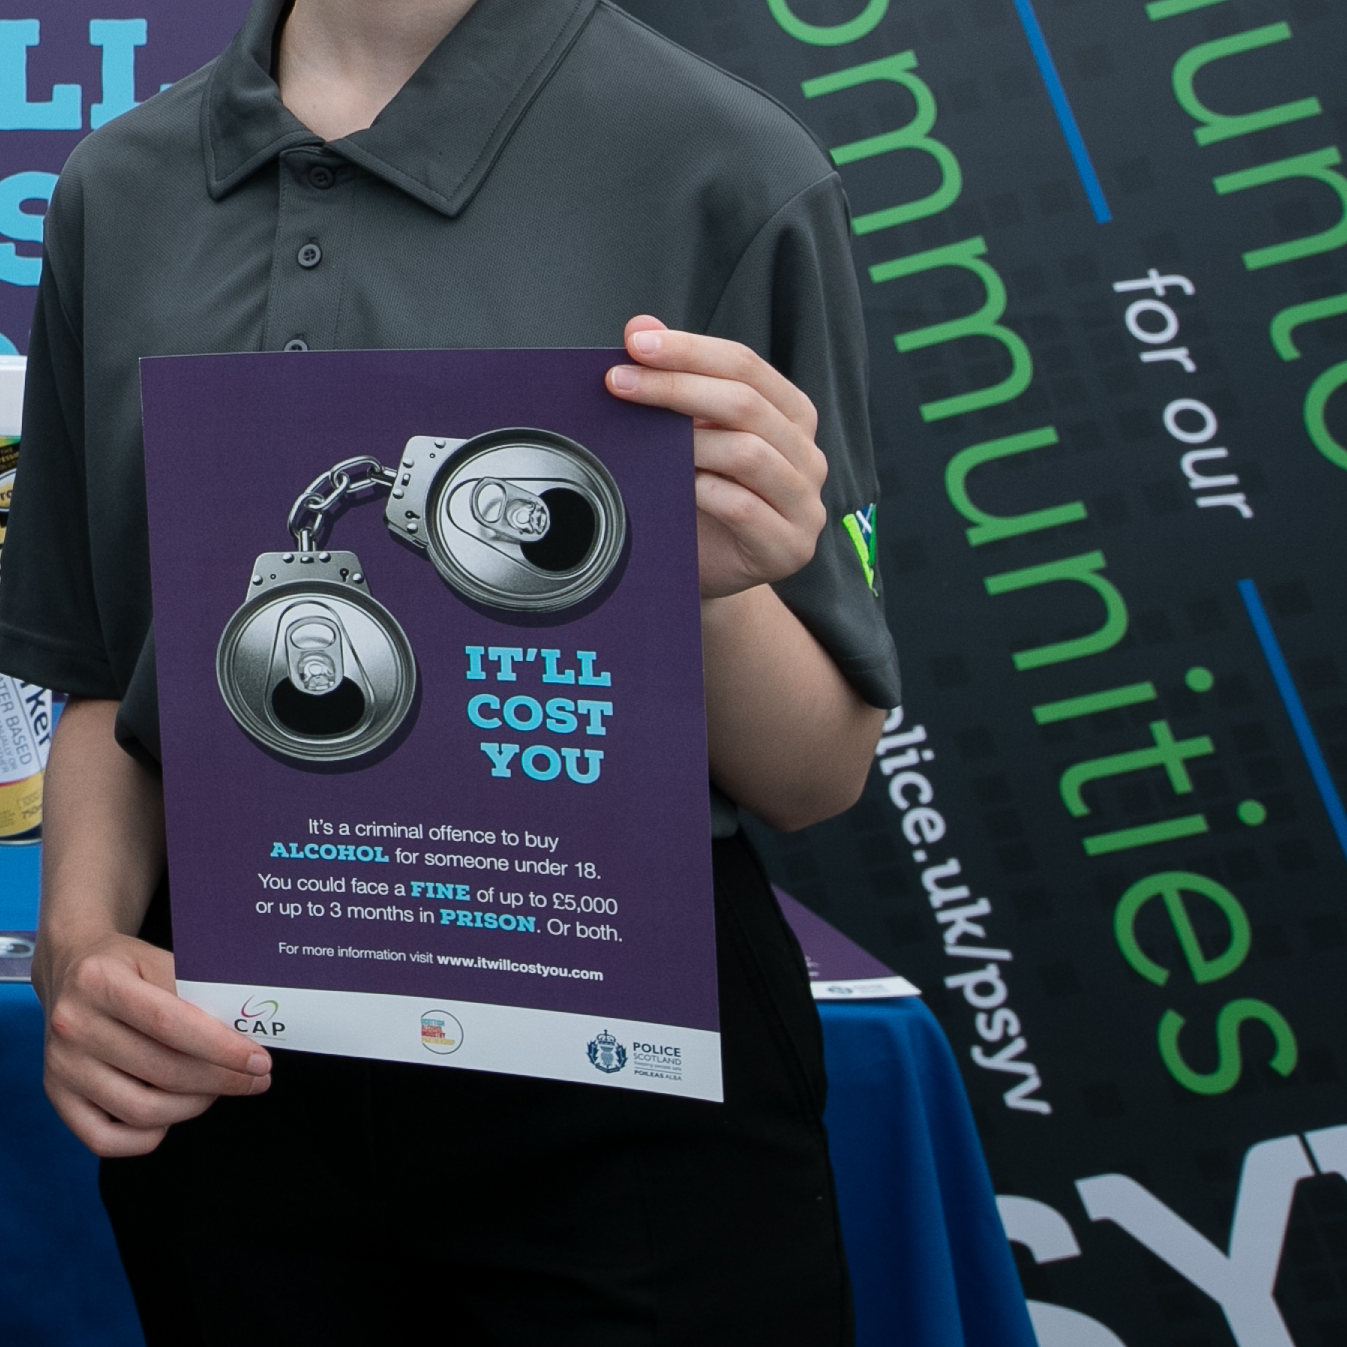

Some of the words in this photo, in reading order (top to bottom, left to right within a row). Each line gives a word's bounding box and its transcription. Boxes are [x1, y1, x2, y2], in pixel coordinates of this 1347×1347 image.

[1112, 267, 1197, 375] for
[1162, 396, 1255, 520] our
[465, 645, 612, 687] IT'LL
[467, 693, 614, 736] COST
[480, 742, 605, 784] YOU
[257, 873, 292, 890] You
[296, 876, 346, 893] could
[350, 877, 389, 896] face
[394, 883, 407, 897] a
[410, 881, 471, 901] FINE
[476, 886, 495, 903] of
[499, 891, 524, 909] up
[528, 891, 548, 908] to
[552, 892, 618, 915] £5,000
[233, 1018, 286, 1037] CAP
[632, 1041, 681, 1058] POLICE
[633, 1052, 682, 1066] SCOTLAND
